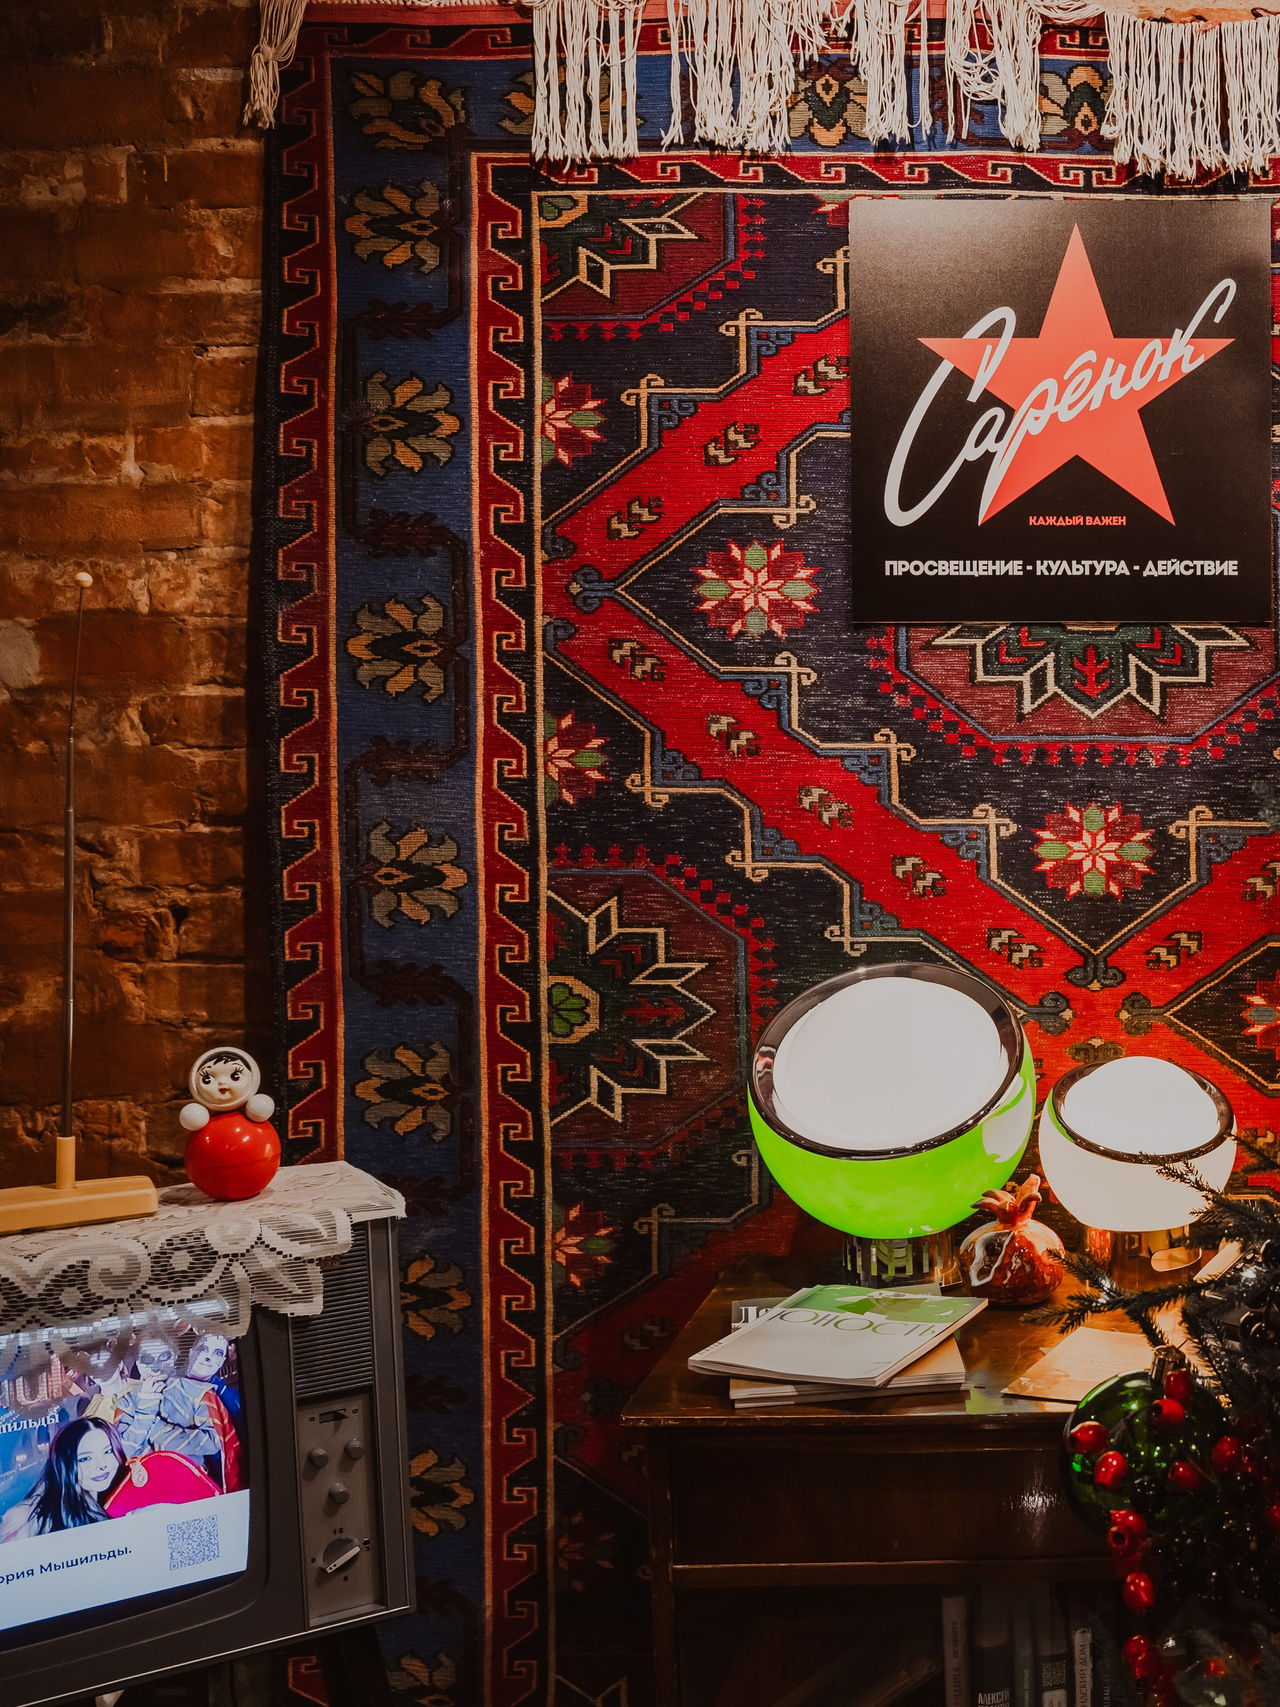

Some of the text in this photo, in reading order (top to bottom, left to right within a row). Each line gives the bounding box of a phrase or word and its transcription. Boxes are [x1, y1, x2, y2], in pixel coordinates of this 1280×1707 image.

[1029, 515, 1126, 527] КАЖДЫЙ ВАЖЕН
[885, 560, 1023, 577] ПРОСВЕЩЕНИЕ
[1036, 560, 1130, 576] КУЛЬТУРА
[1143, 558, 1238, 577] ДЕЙСТВИЕ
[39, 1546, 132, 1575] Мышильды.
[1078, 1644, 1087, 1666] ДОМ
